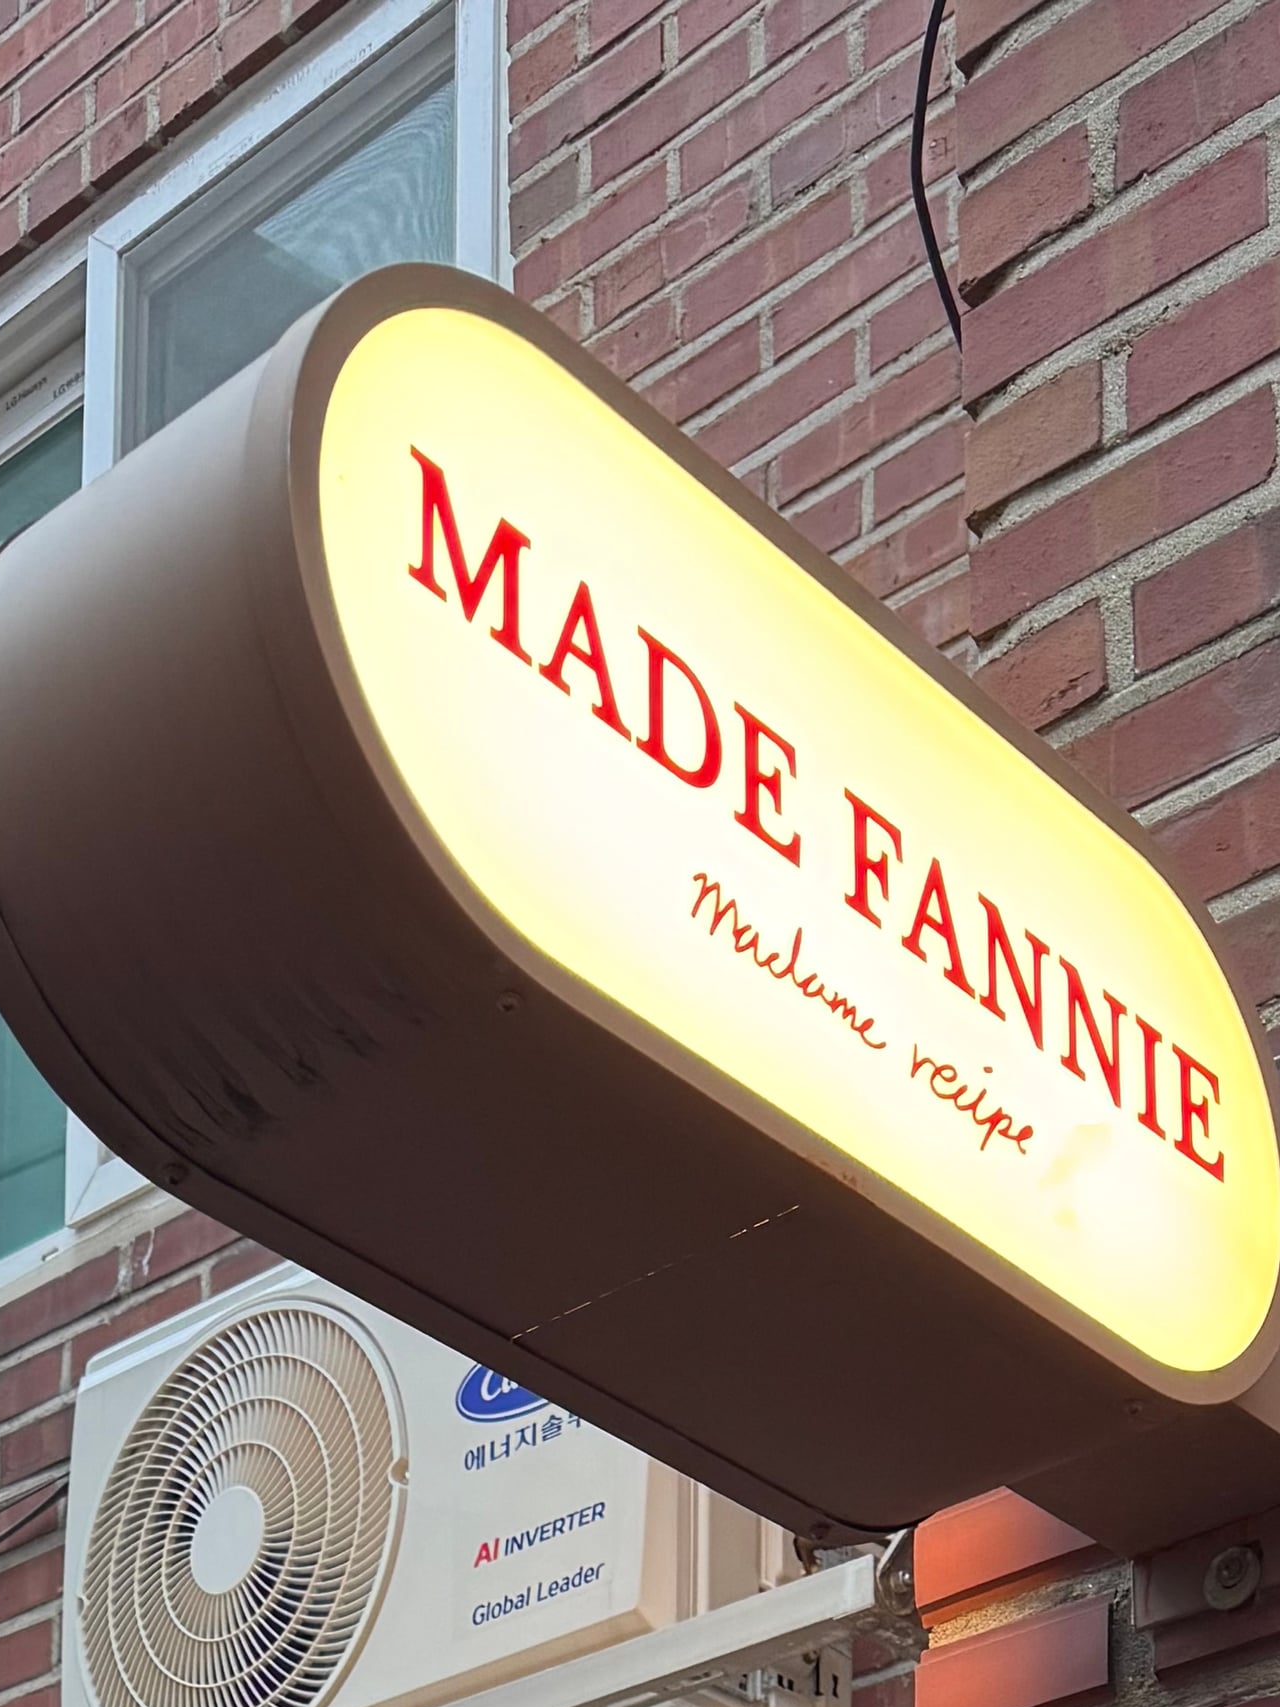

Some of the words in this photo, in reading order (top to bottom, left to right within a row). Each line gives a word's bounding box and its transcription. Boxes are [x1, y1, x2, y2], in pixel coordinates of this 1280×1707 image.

[407, 444, 802, 868] MADE
[843, 785, 1226, 1183] FANNIE
[473, 1537, 500, 1568] AI
[504, 1501, 606, 1556] INVERTER
[472, 1586, 531, 1626] Global
[536, 1562, 606, 1603] Leader
